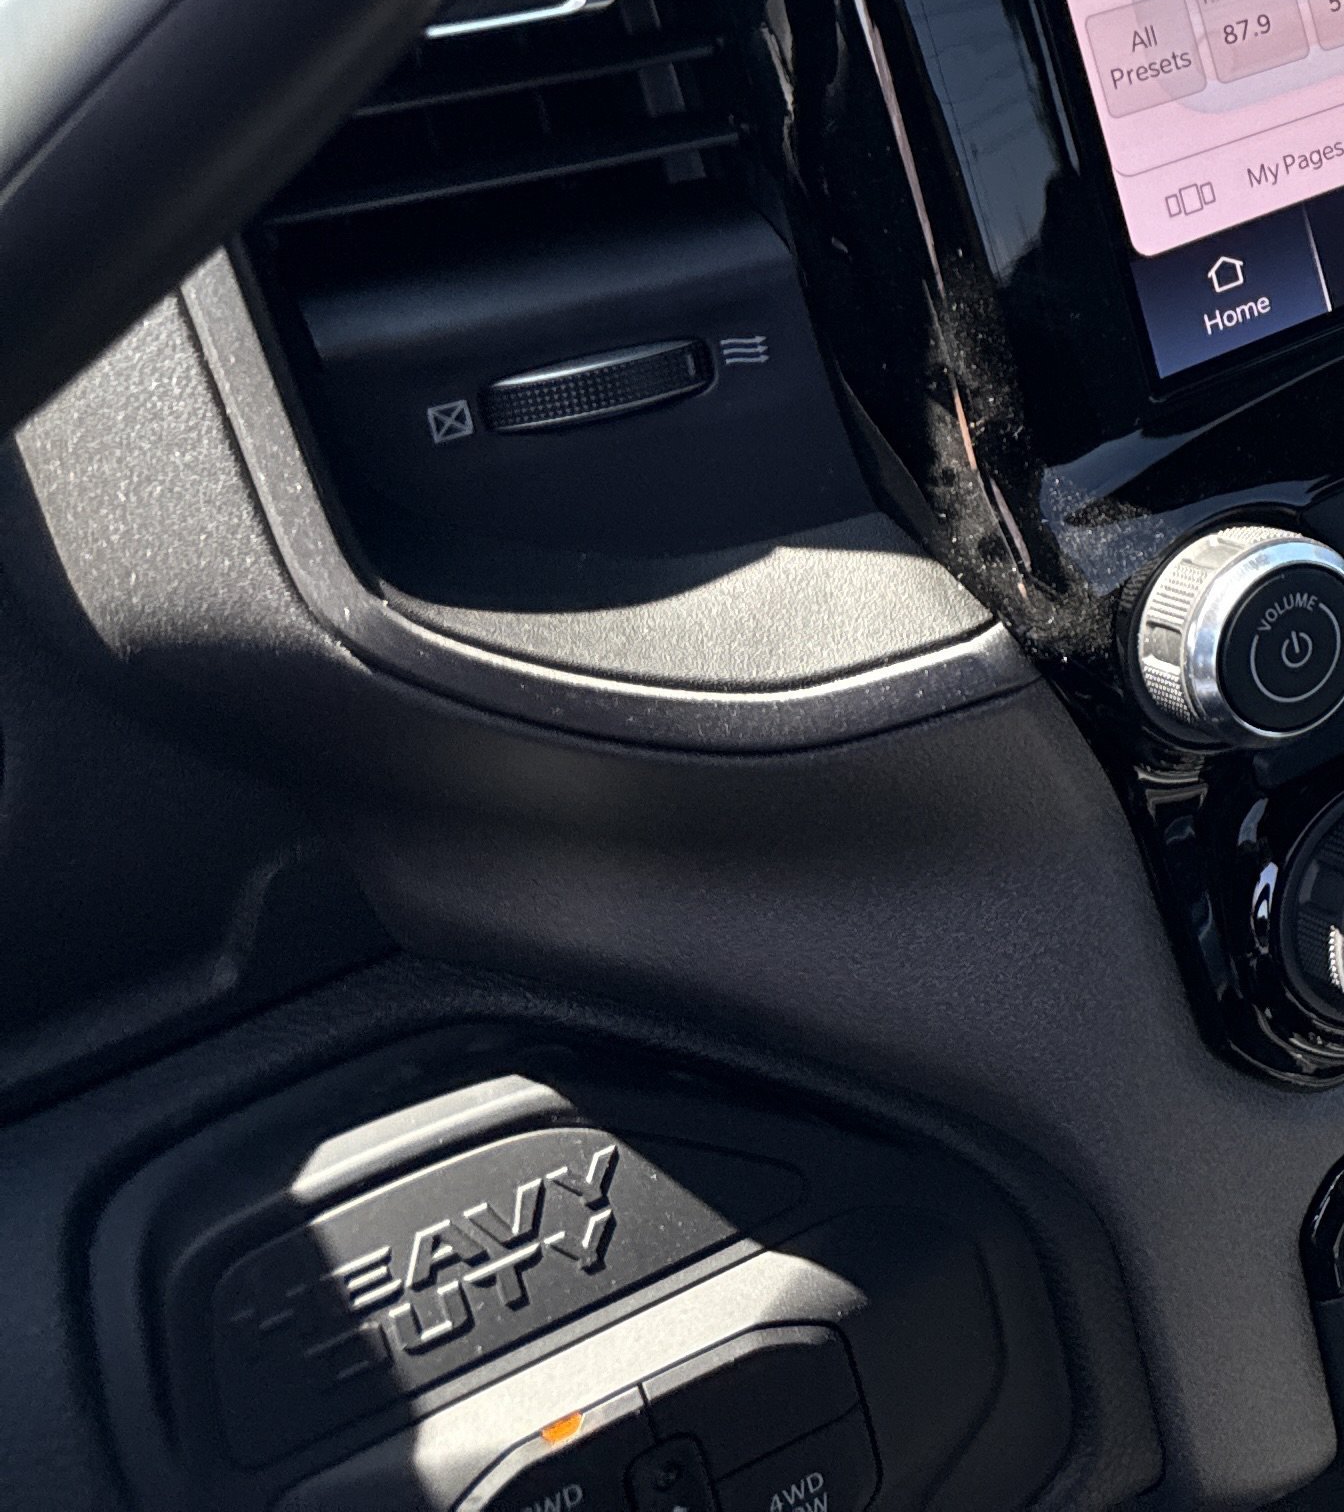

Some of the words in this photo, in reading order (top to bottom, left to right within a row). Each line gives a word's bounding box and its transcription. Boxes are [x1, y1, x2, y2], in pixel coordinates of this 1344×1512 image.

[1131, 25, 1158, 53] All
[1222, 13, 1272, 45] 87.9
[1110, 50, 1193, 90] Presets
[1246, 162, 1280, 190] My
[1203, 293, 1272, 335] Home
[1257, 591, 1319, 634] VOLUME
[230, 1142, 619, 1334] EAVY
[304, 1206, 618, 1381] UTY
[524, 1483, 584, 1512] WD
[769, 1471, 825, 1512] 4WD
